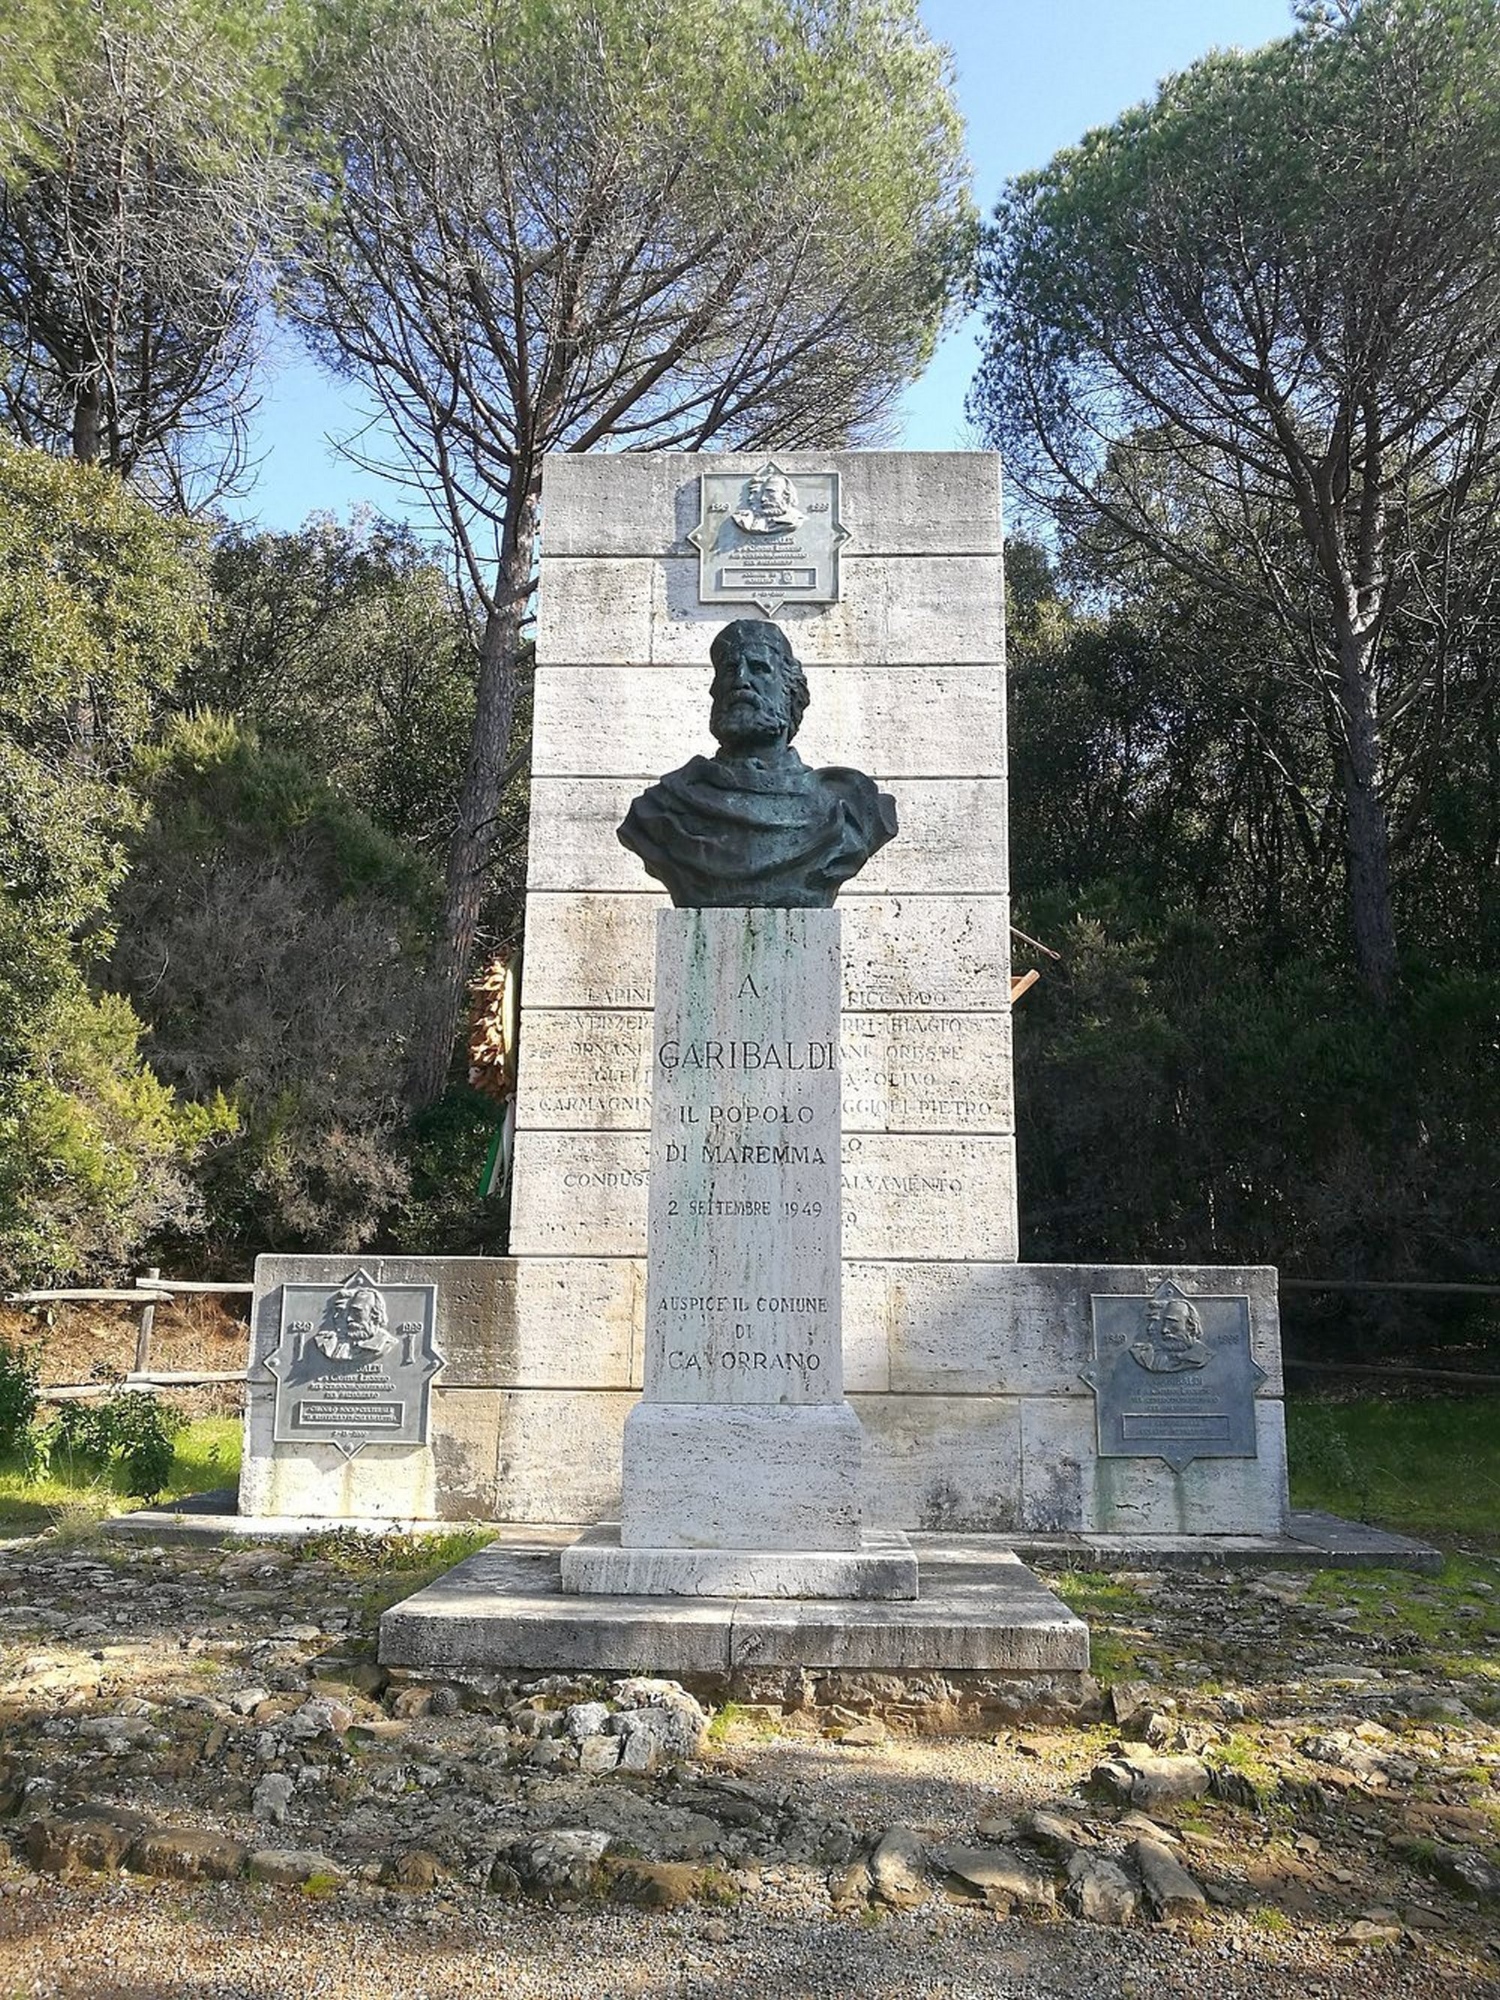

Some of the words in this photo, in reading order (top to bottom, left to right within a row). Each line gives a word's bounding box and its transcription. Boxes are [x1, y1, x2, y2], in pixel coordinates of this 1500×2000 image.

[738, 973, 760, 999] A
[848, 991, 946, 1007] RICCARDO
[658, 1041, 835, 1070] GARIBALDI
[540, 1097, 653, 1111] CARMAGNIN
[919, 1100, 992, 1116] PIETRO
[680, 1106, 699, 1124] IL
[710, 1106, 814, 1124] POPOLO
[666, 1145, 687, 1163] DI
[702, 1146, 826, 1165] MAREMMA
[841, 1176, 962, 1193] ALVAMENTO
[668, 1200, 679, 1216] 2
[689, 1200, 771, 1217] SETTEMBRE
[784, 1201, 822, 1218] 1949
[658, 1297, 728, 1312] AUSPICE
[733, 1297, 749, 1313] IL
[756, 1298, 828, 1314] COMUNE
[735, 1323, 752, 1340] DI
